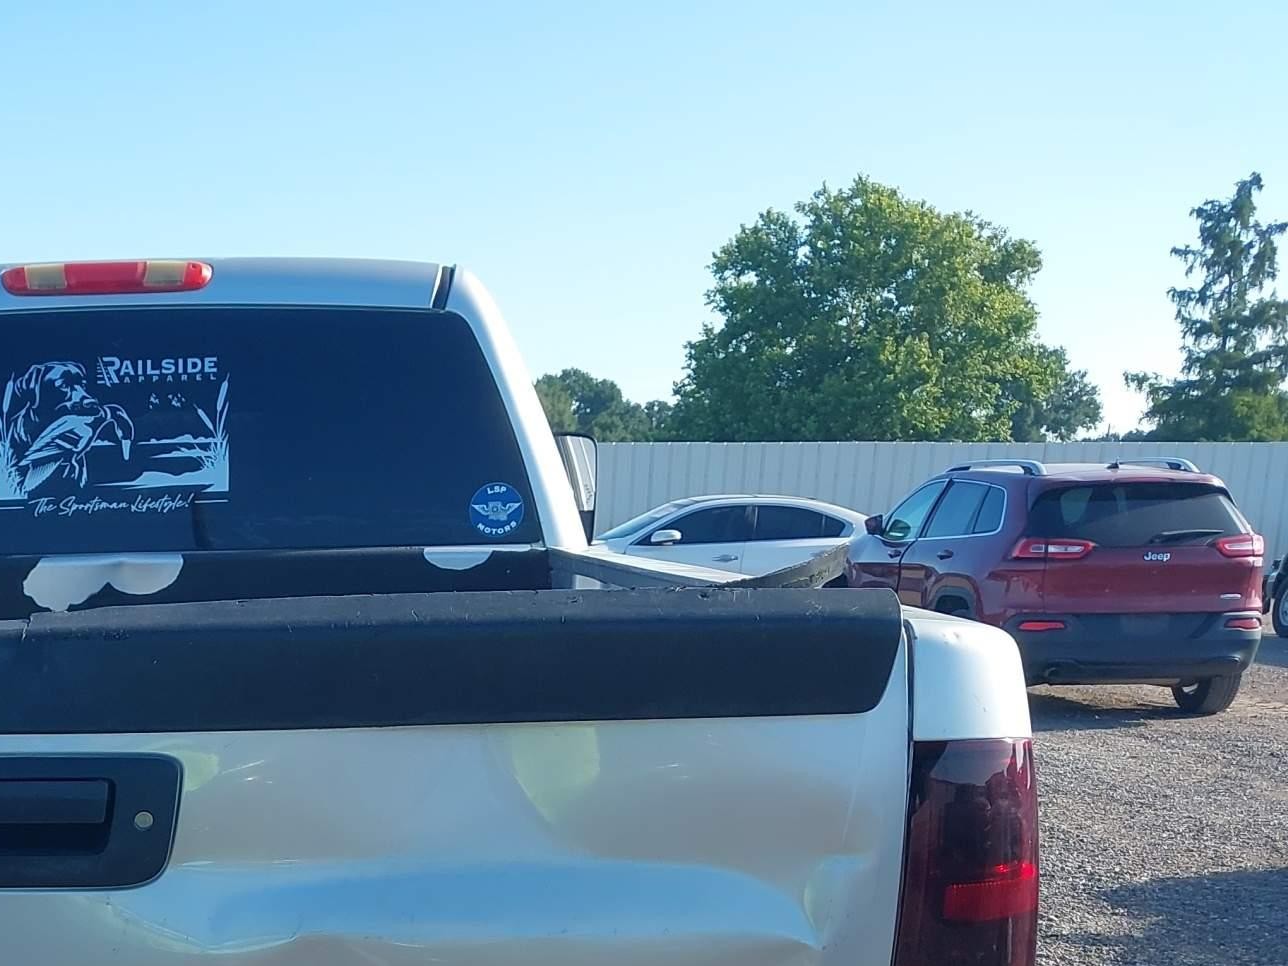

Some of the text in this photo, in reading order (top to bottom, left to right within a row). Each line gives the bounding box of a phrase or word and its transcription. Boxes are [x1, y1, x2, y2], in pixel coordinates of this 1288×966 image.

[96, 356, 217, 387] RAILSIDE
[123, 373, 217, 383] APPAREL
[487, 486, 506, 494] LSP
[28, 493, 194, 517] The Sportsman Lifestyle!
[477, 521, 516, 534] MOTORS
[1144, 552, 1170, 561] Jeep
